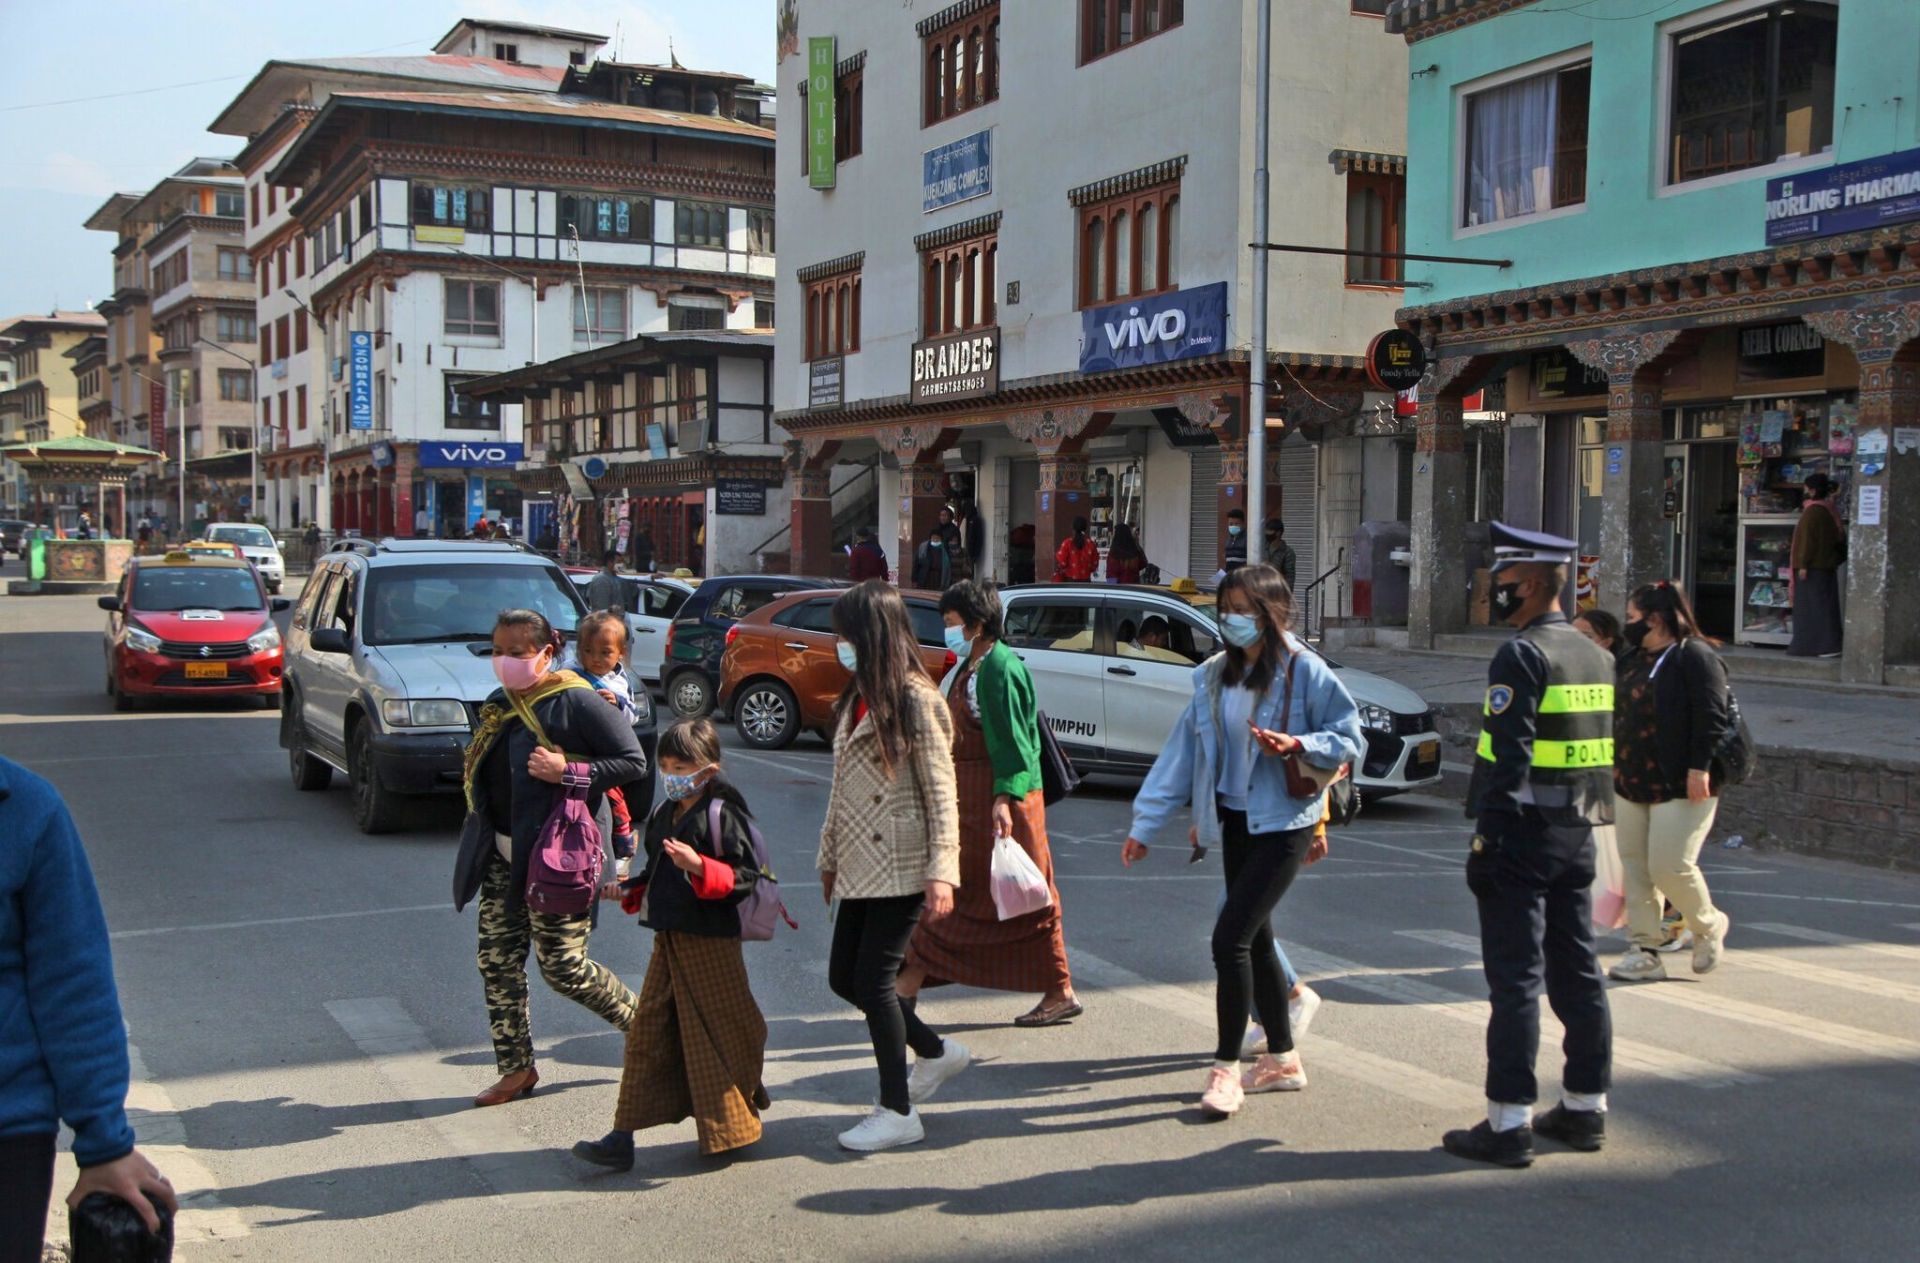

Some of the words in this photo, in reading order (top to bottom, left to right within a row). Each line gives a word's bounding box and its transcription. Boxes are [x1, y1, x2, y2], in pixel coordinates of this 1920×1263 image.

[815, 47, 828, 172] HOTEL
[957, 165, 989, 191] COMPLEX
[1766, 188, 1841, 221] NORLING
[1775, 322, 1822, 353] CORNER
[355, 348, 368, 402] ZOMBALA
[914, 336, 993, 382] BRANDED
[1380, 368, 1402, 378] Foody
[920, 376, 985, 397] GARMENTS&SHOES
